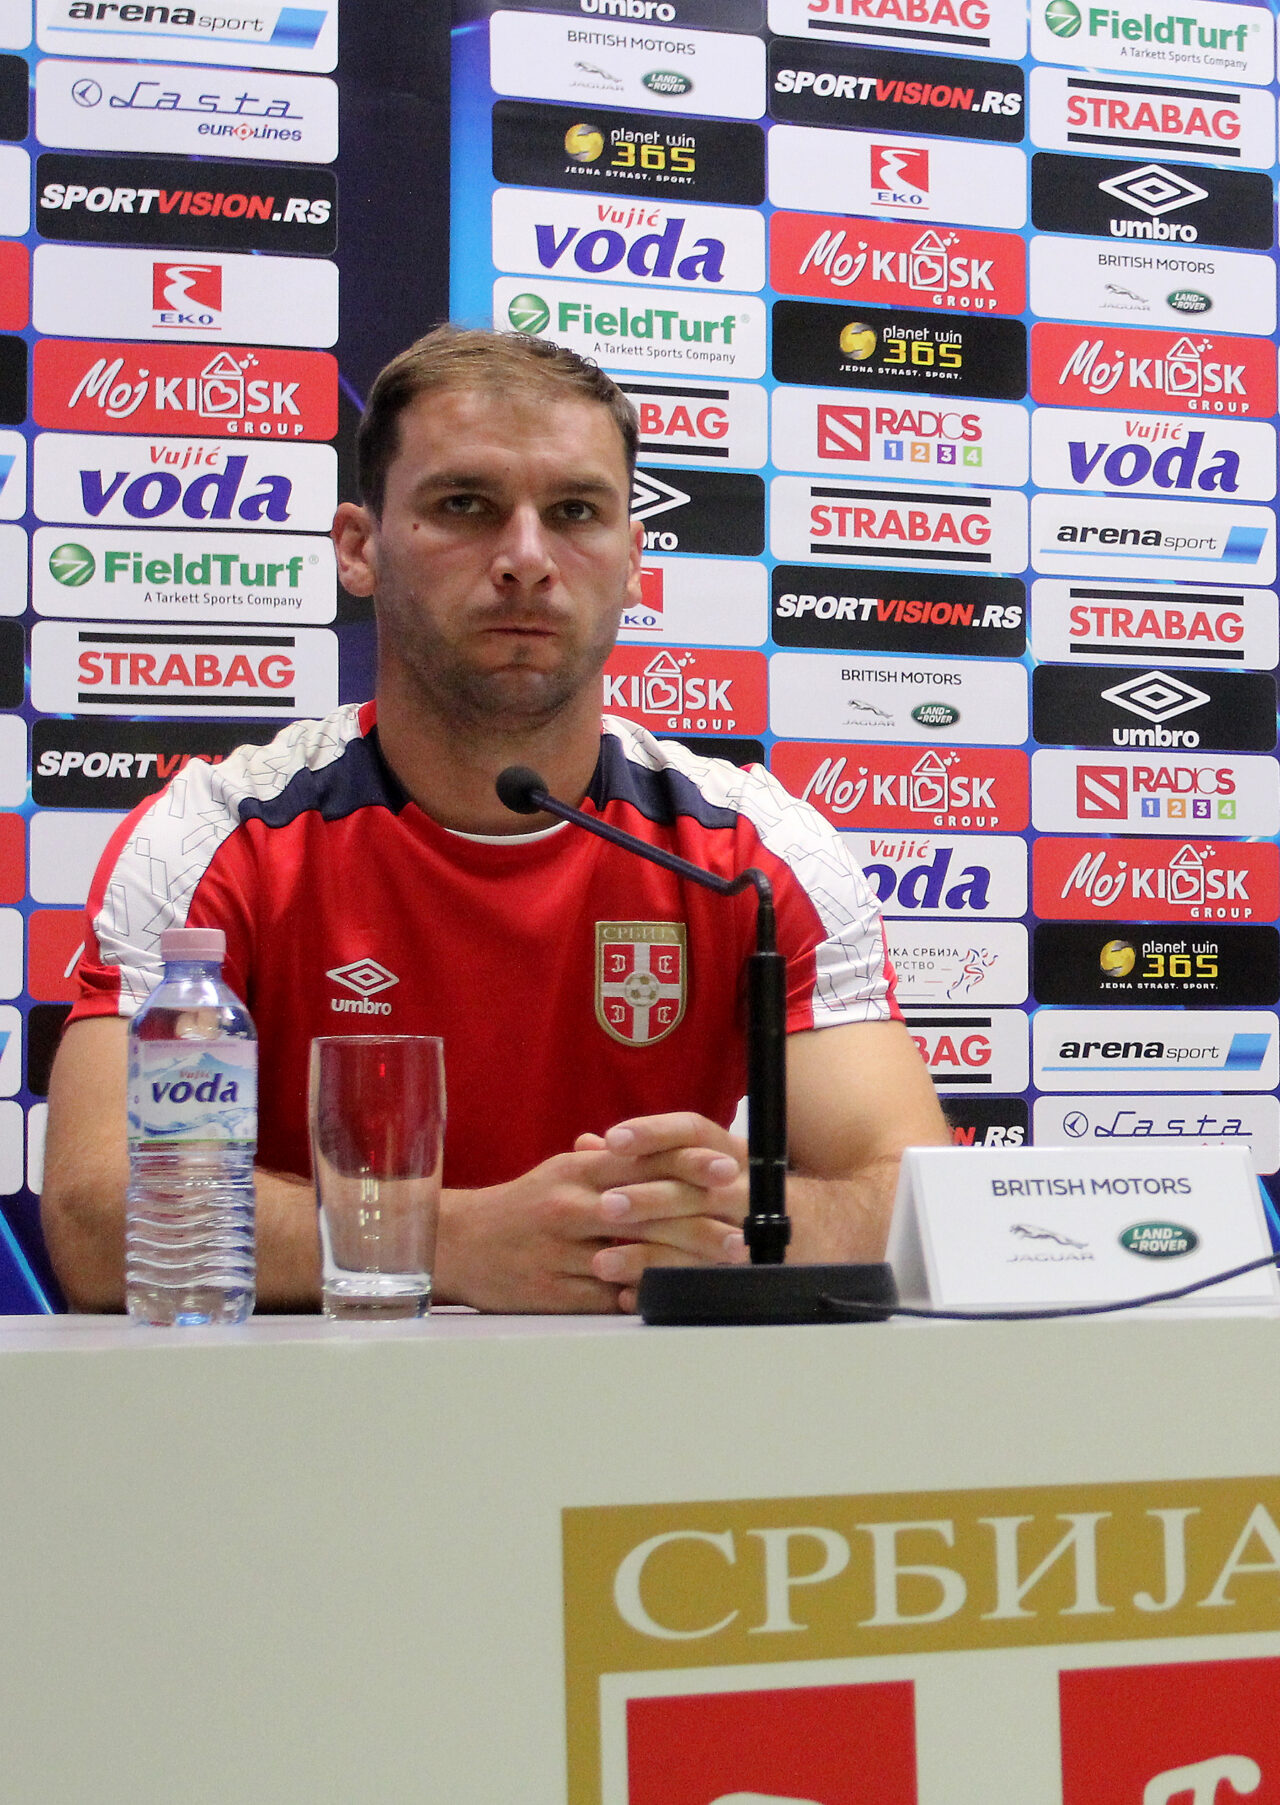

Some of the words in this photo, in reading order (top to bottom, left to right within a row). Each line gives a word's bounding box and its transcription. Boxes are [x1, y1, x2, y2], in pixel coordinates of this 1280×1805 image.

[1090, 8, 1247, 55] FieldTurf
[109, 82, 303, 119] Lasta
[775, 69, 1022, 115] SPORTVISION.RS
[40, 184, 331, 224] SPORTVISION.RS
[878, 192, 922, 204] EKO
[598, 205, 660, 228] Vujić
[1110, 218, 1197, 242] umbro
[535, 216, 725, 282] voda
[1099, 254, 1152, 268] BRITISH
[1157, 259, 1214, 274] MOTORS
[161, 314, 213, 324] EKO
[559, 302, 735, 344] FieldTurf
[883, 325, 929, 342] planet
[935, 330, 962, 343] win
[883, 339, 962, 367] 365
[68, 358, 149, 418] Moj
[227, 421, 303, 435] GROUP
[150, 446, 221, 469] Vujić
[889, 443, 898, 458] 1
[915, 445, 926, 460] 2
[941, 446, 952, 463] 3
[966, 448, 979, 464] 4
[80, 453, 292, 522] voda
[810, 505, 991, 545] STRABAG
[105, 551, 303, 587] FieldTurf
[145, 592, 151, 601] A
[157, 592, 198, 603] Tarkett
[204, 593, 243, 606] Sports
[248, 594, 302, 608] Company
[1069, 606, 1244, 643] STRABAG
[78, 651, 295, 688] STRABAG
[668, 718, 735, 730] GROUP
[1113, 725, 1199, 748] umbro
[802, 757, 868, 814] Moj
[934, 815, 998, 827] GROUP
[870, 840, 930, 862] Vujić
[862, 845, 990, 910] oda
[1143, 941, 1186, 957] planet
[1192, 941, 1218, 953] win
[1143, 954, 1218, 977] 365
[331, 997, 391, 1015] umbro
[152, 1073, 237, 1103] voda
[1095, 1111, 1252, 1137] Lasta
[992, 1179, 1085, 1196] BRITISH
[1091, 1178, 1191, 1195] MOTORS
